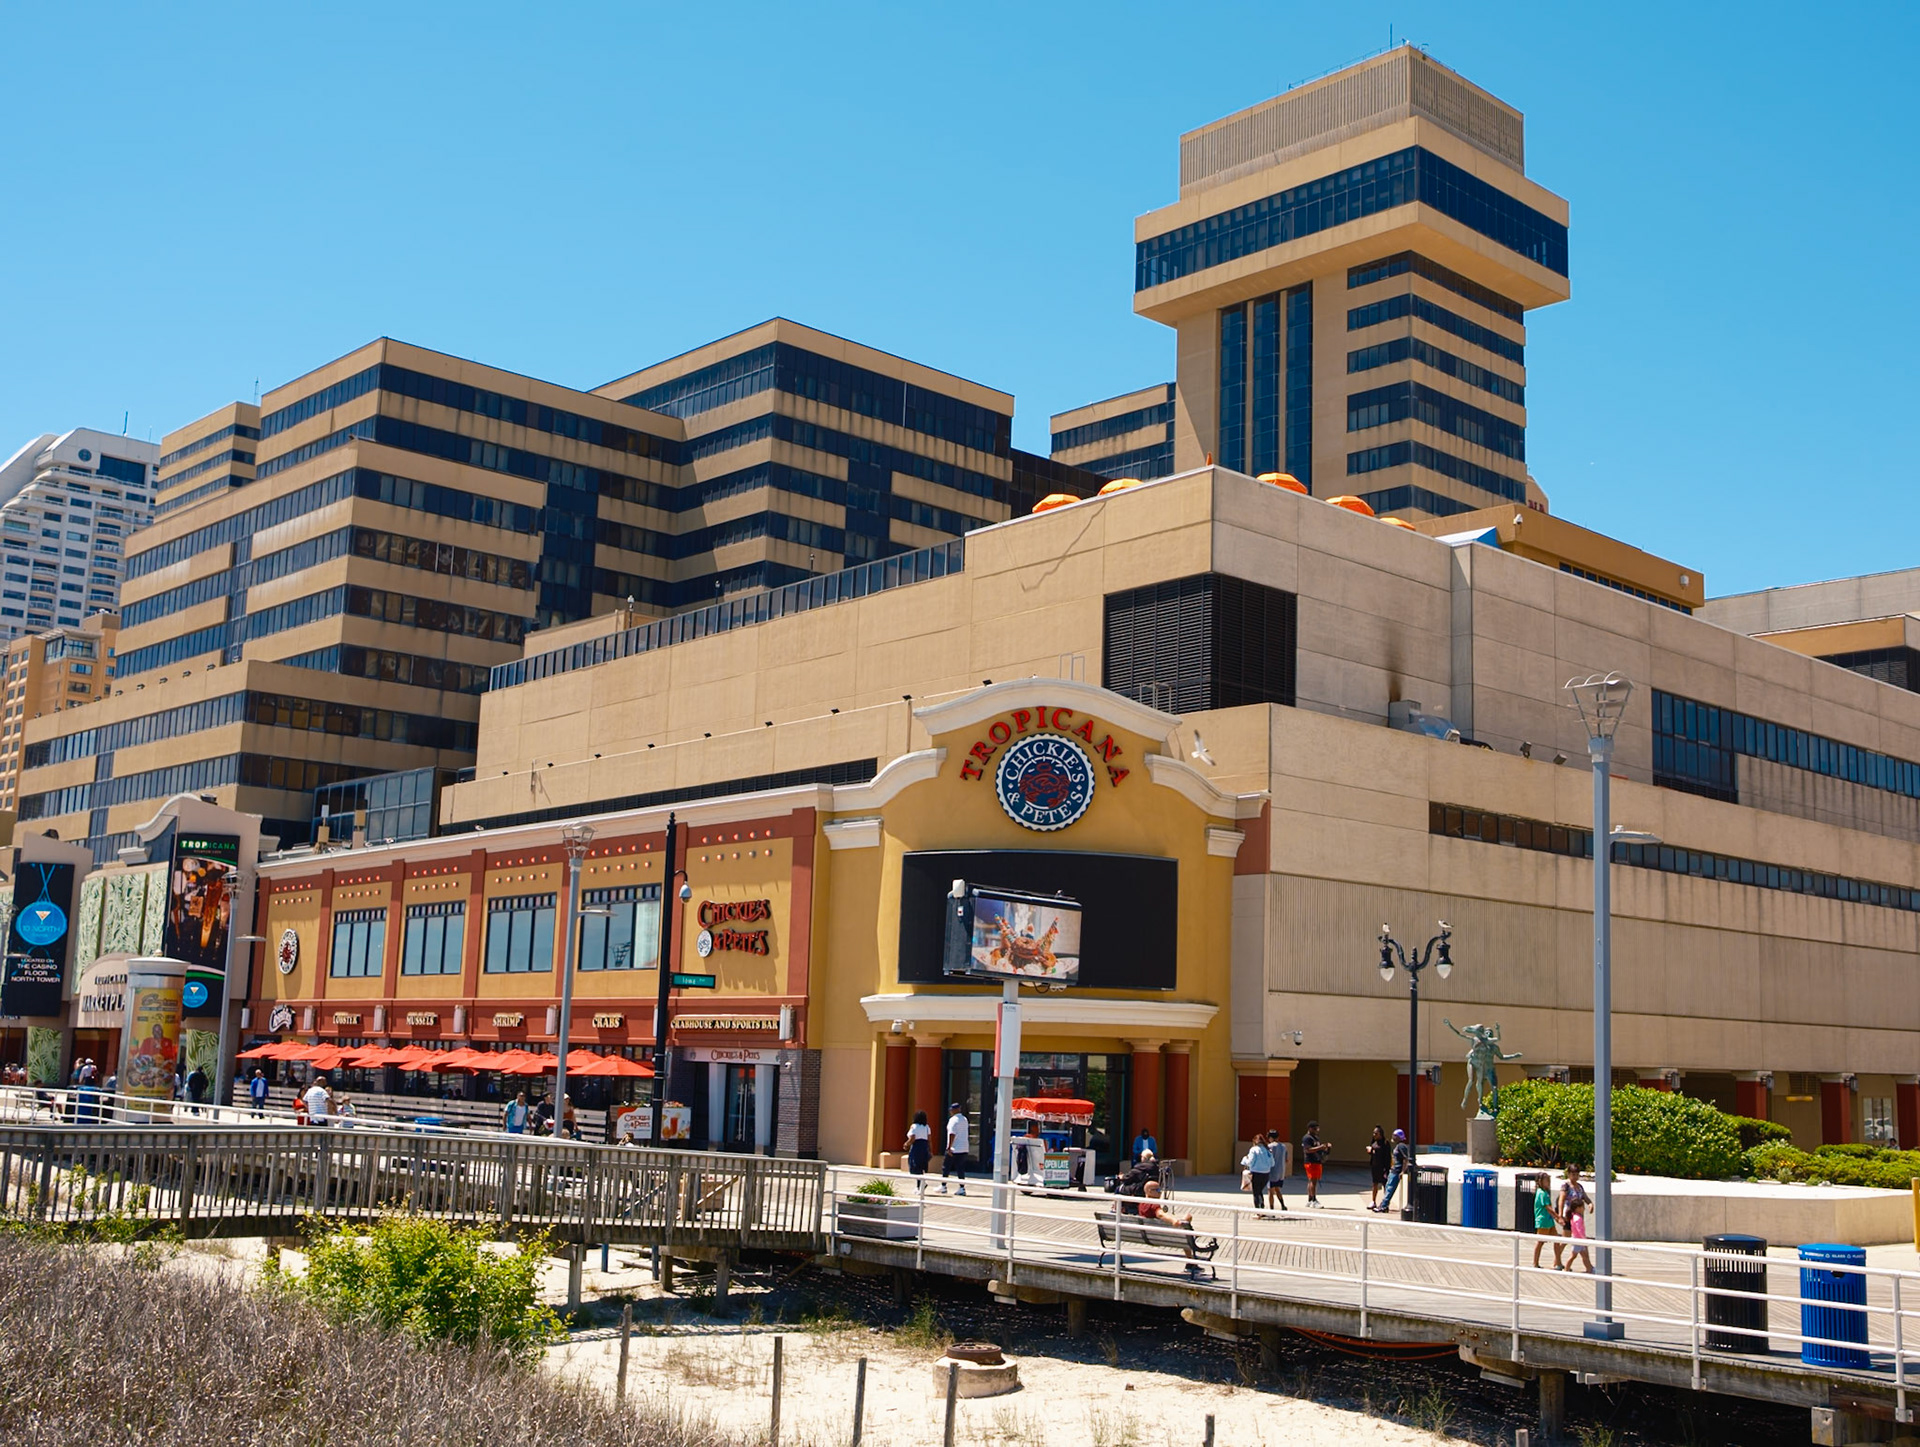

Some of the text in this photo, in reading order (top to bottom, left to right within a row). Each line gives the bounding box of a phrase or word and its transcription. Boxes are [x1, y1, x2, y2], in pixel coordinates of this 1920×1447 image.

[959, 705, 1130, 788] TROPICANA
[1005, 741, 1086, 784] CHICKIE'S
[1006, 790, 1085, 825] & PETE'S
[181, 839, 237, 850] TROPICANA
[697, 899, 771, 929] CHICKIE'S
[32, 925, 61, 934] NORTH
[721, 928, 769, 957] PETE'S
[24, 969, 48, 977] FLOOR
[31, 963, 58, 971] CASINO
[36, 976, 61, 984] TOWER
[332, 1013, 360, 1025] LOBSTER
[406, 1014, 436, 1026] MUSSELS
[492, 1015, 522, 1027] SHRIMP
[592, 1016, 621, 1028] CRABS
[670, 1019, 779, 1030] CRABHOUSE AND SPORTS BAR
[1045, 1159, 1058, 1169] OPEN
[1057, 1159, 1069, 1169] LATE
